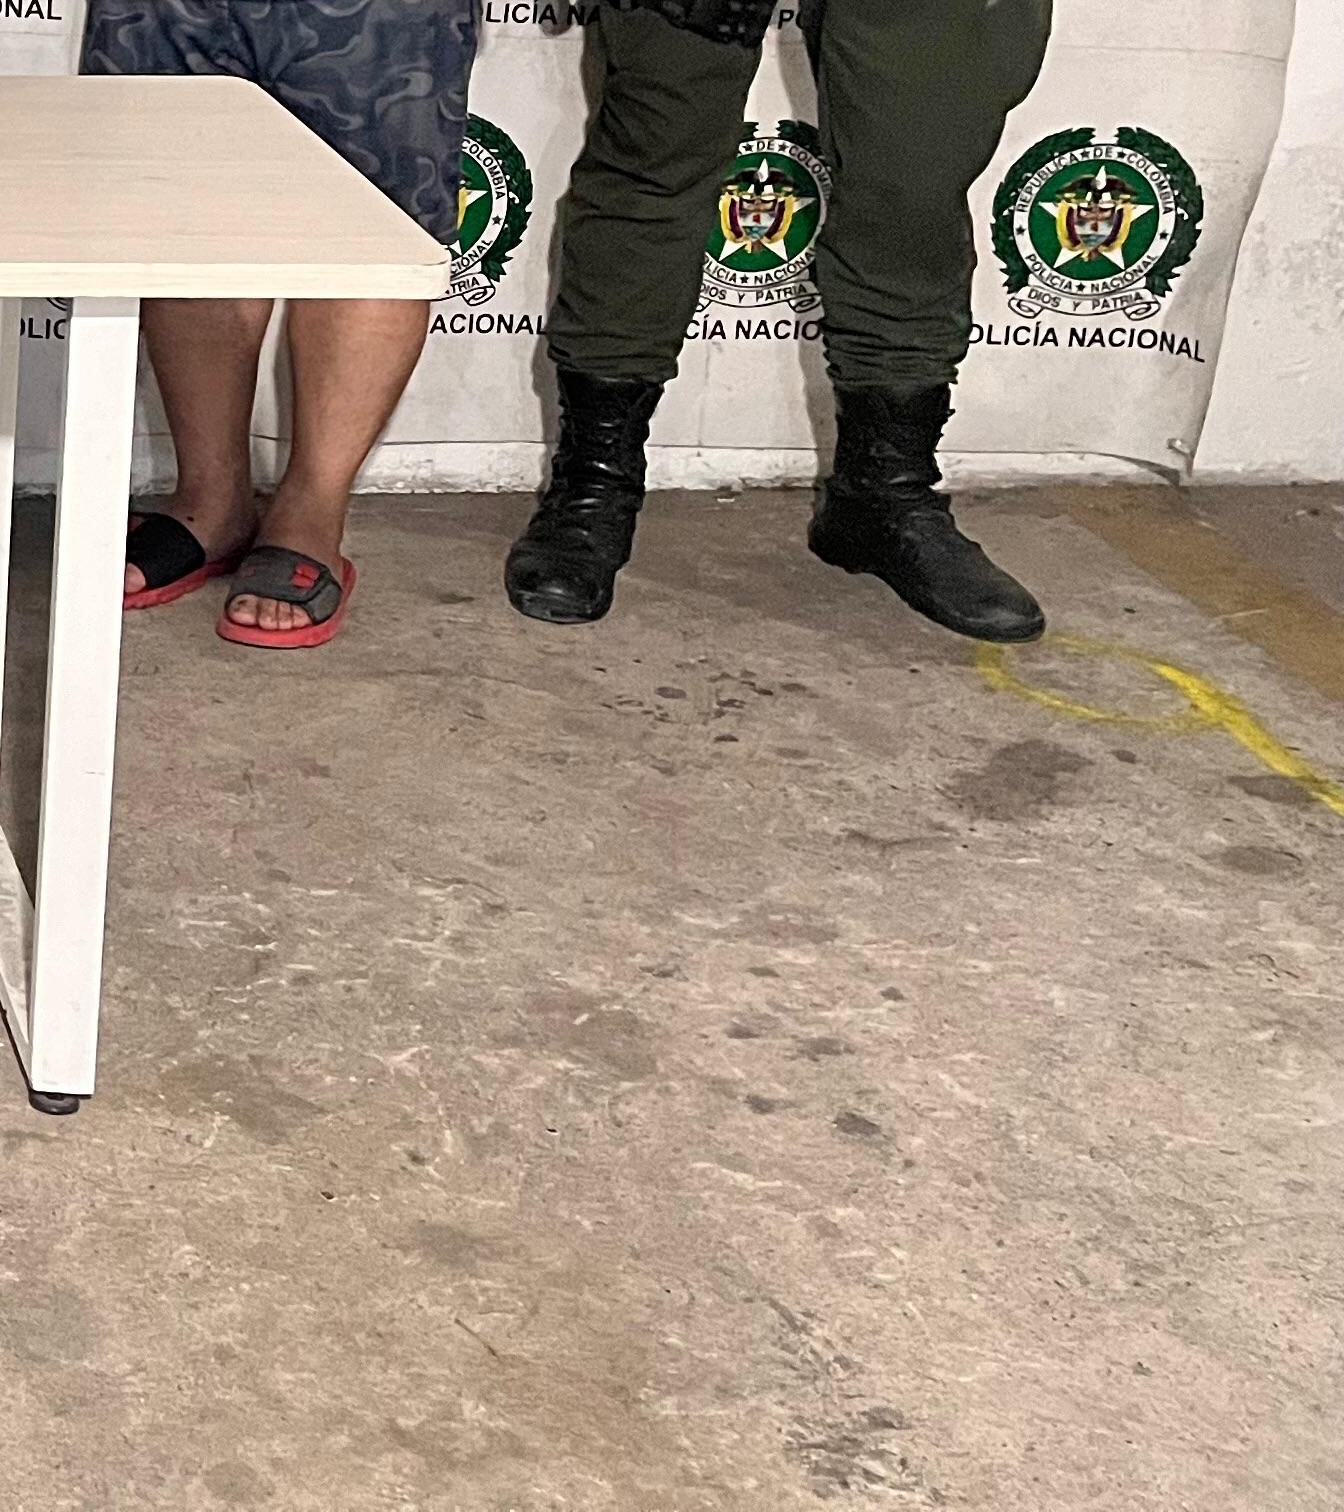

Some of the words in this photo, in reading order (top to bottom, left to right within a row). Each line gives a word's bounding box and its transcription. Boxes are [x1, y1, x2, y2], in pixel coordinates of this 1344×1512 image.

[485, 0, 557, 25] LICÍA
[1093, 148, 1114, 158] DE
[1128, 155, 1173, 216] COLOMBIA
[1025, 254, 1071, 291] POLICIA
[755, 284, 808, 302] PATRIA
[1027, 289, 1061, 307] DIOS
[1091, 292, 1144, 310] PATRIA
[430, 313, 548, 335] ACIONAL
[735, 319, 821, 340] NACIO
[969, 321, 1059, 347] OLICÍA
[1068, 327, 1205, 363] NACIONAL
